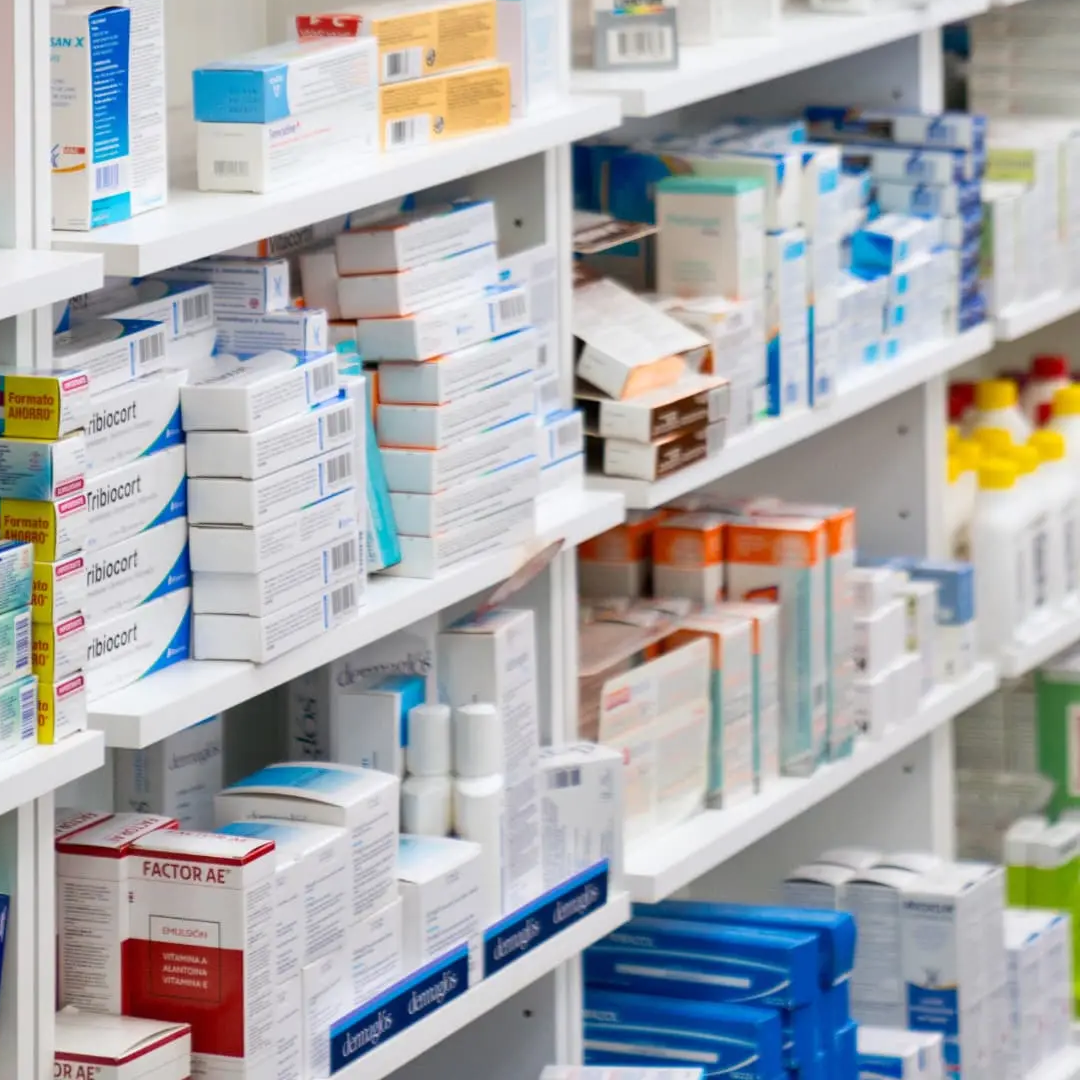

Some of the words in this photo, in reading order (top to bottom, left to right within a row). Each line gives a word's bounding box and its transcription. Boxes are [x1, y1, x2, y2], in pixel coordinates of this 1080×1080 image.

[8, 391, 54, 407] Formato
[88, 401, 137, 435] ribiocort
[88, 477, 141, 512] Tribiocort
[4, 515, 49, 530] Formato
[87, 550, 138, 588] ribiocort
[87, 624, 138, 660] ribiocort
[143, 861, 202, 881] FACTOR
[162, 952, 200, 964] VITAMINA
[163, 976, 201, 988] VITAMINA
